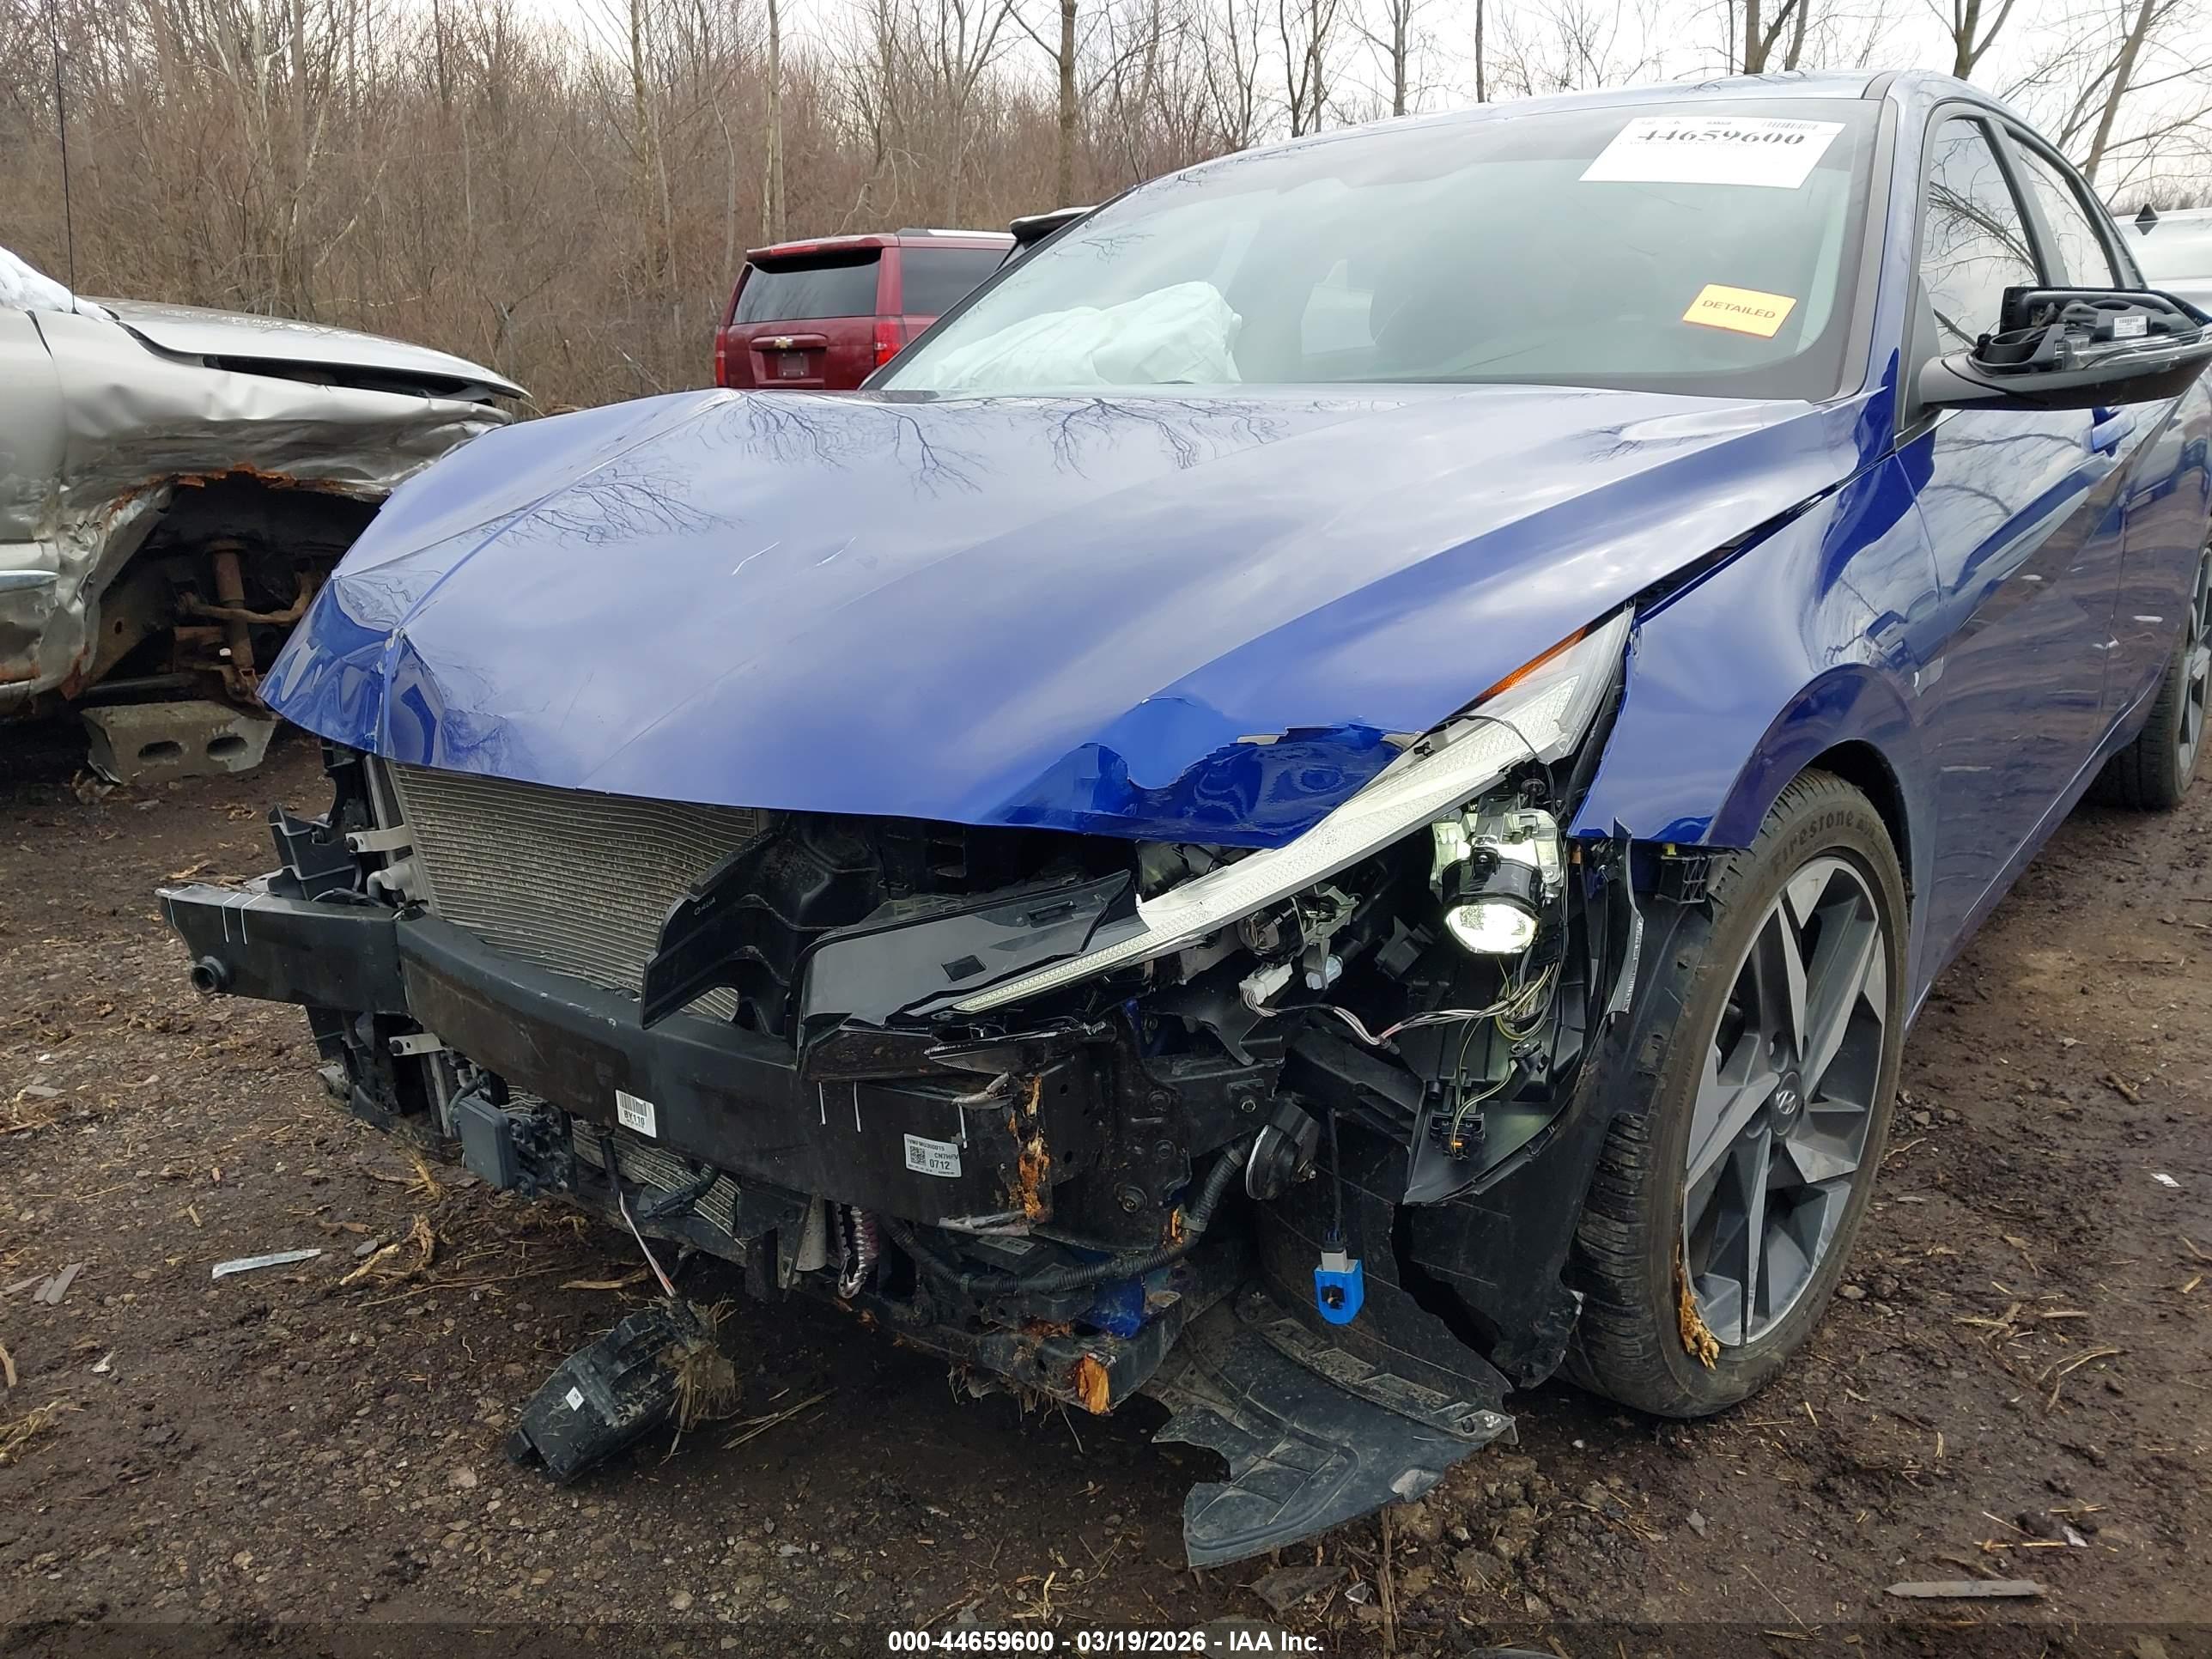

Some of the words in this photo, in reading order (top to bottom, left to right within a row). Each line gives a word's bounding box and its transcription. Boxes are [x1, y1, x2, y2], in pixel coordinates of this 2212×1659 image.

[1702, 300, 1777, 319] DETAILED
[1771, 810, 1854, 876] Firestone
[929, 1158, 951, 1170] 0712
